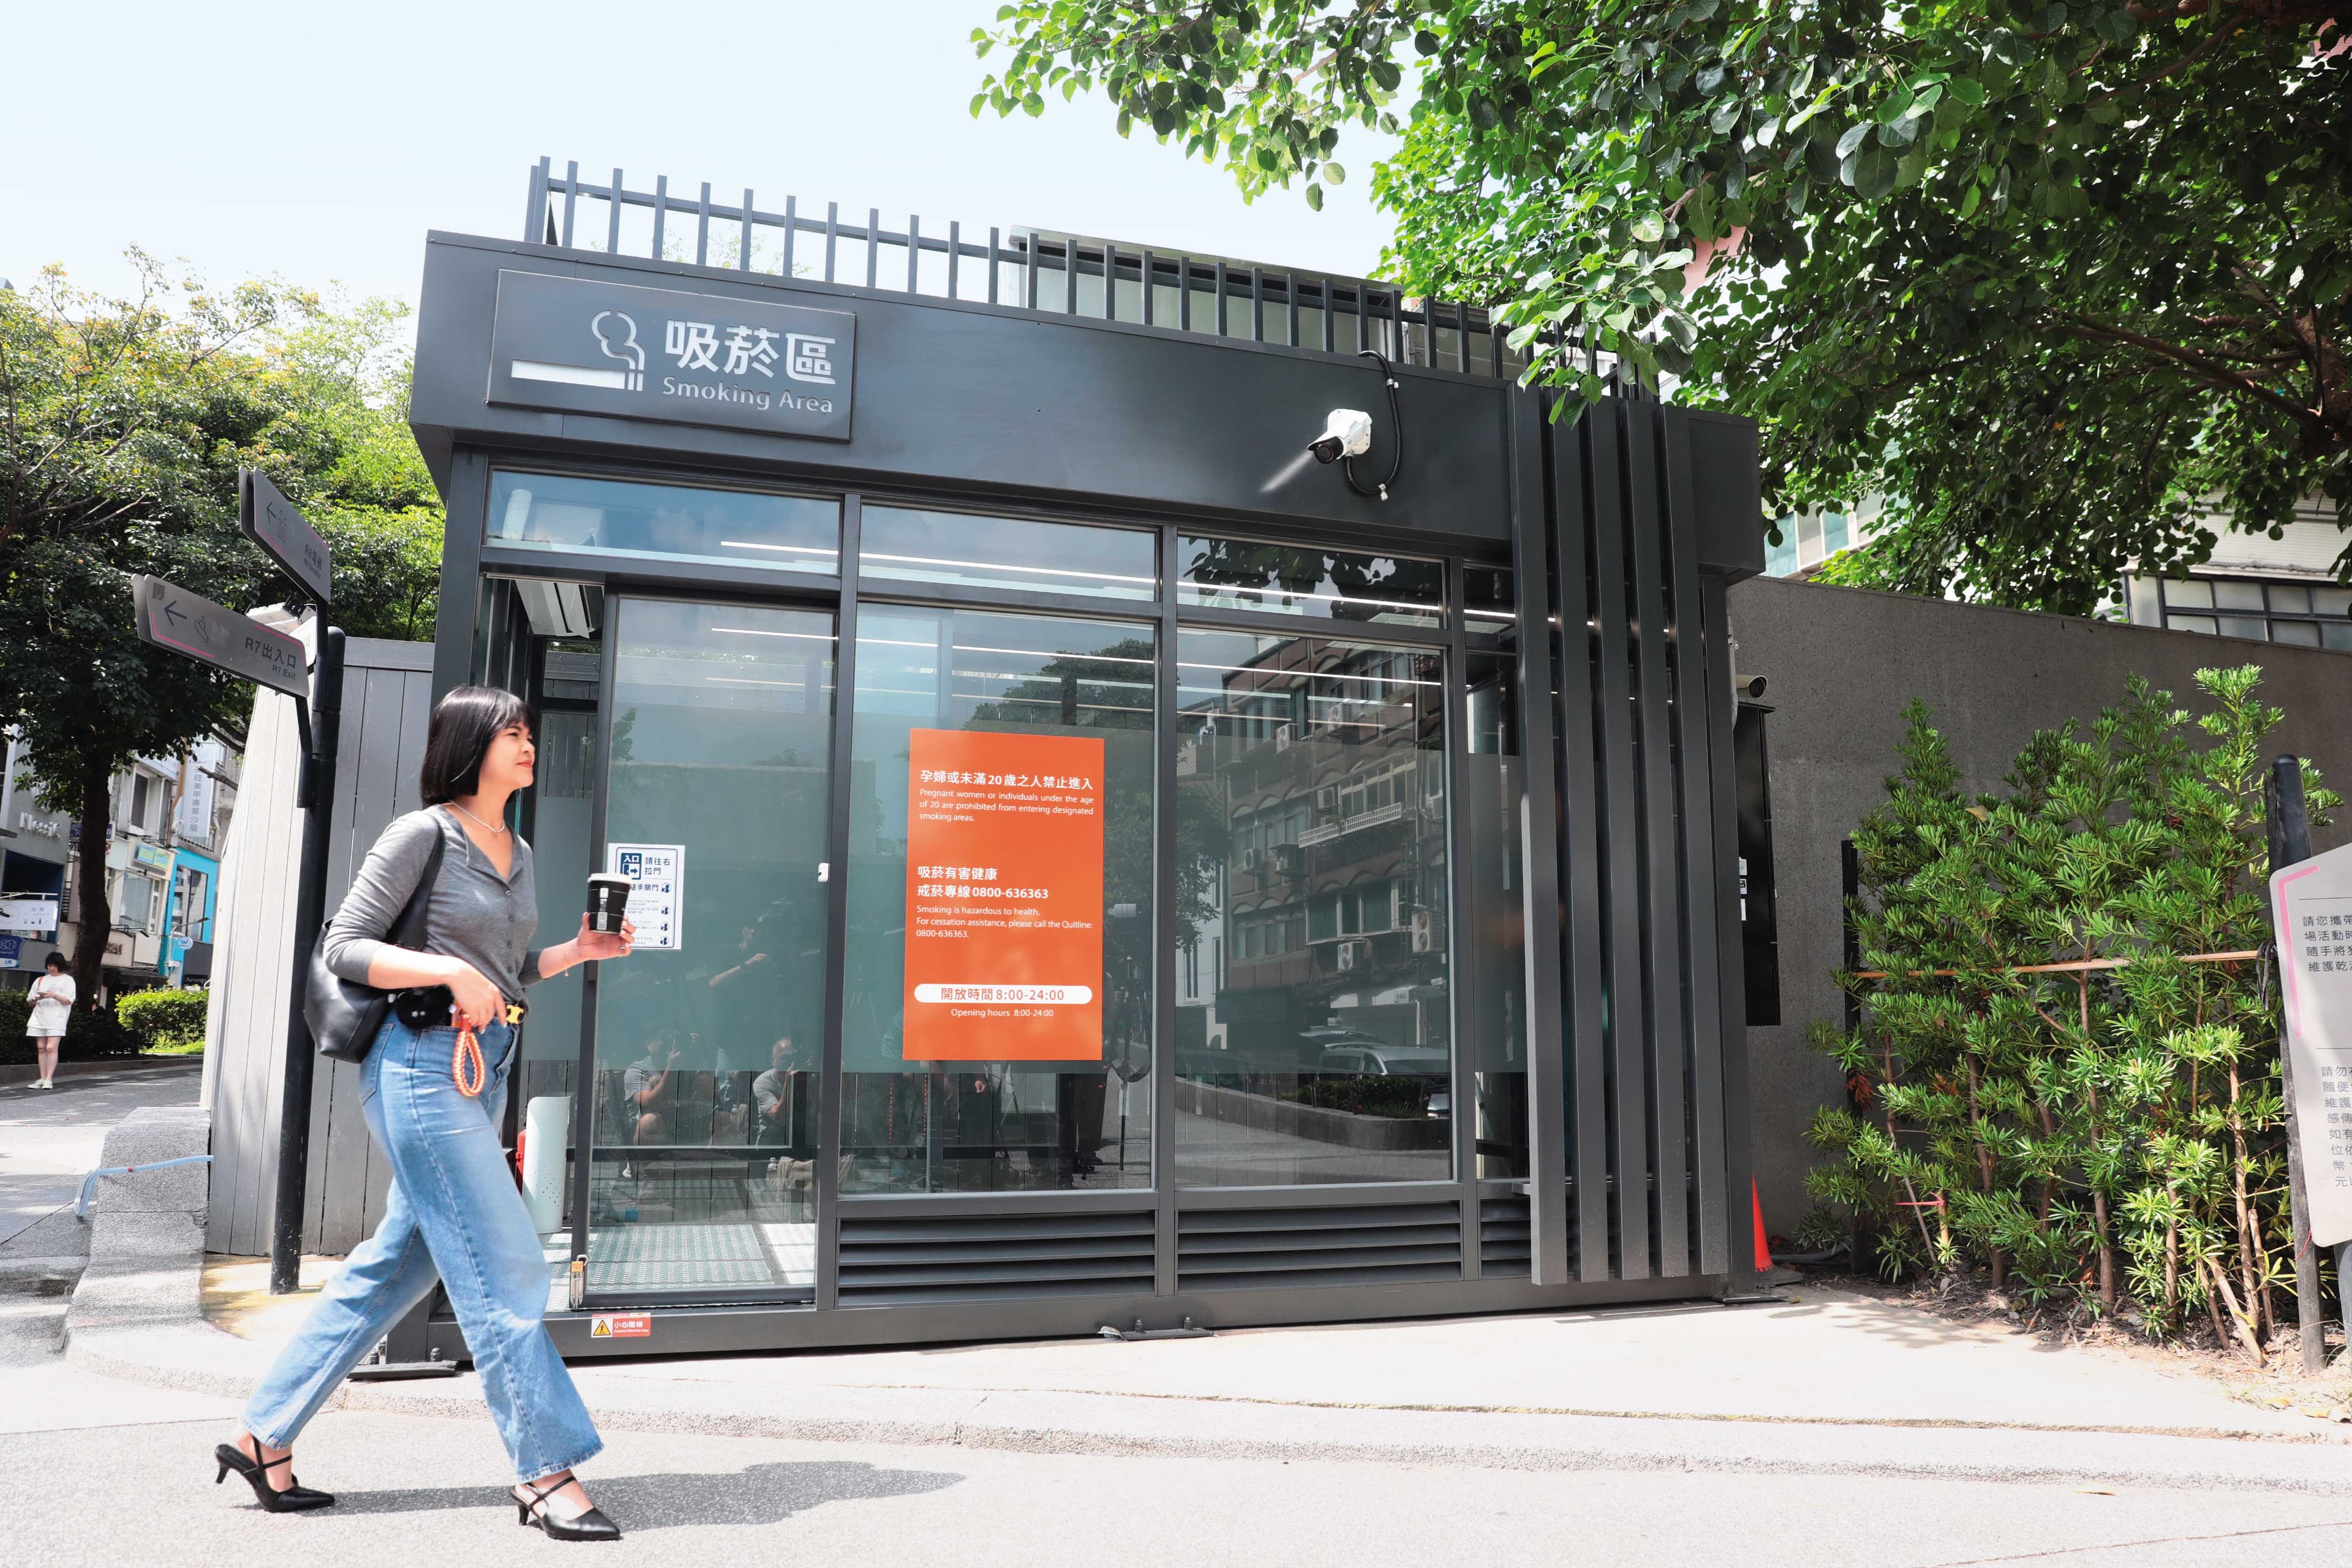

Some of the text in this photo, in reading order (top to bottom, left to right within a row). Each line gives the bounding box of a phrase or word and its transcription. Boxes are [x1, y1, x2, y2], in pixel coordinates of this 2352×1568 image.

[665, 319, 836, 385] 吸菸區
[662, 375, 832, 413] Smoking Area
[245, 636, 296, 669] R7出入口
[273, 664, 296, 680] R7 Exit
[920, 789, 954, 798] Pregnant
[1019, 805, 1050, 815] entering
[1053, 806, 1093, 815] designated
[919, 813, 951, 822] smoking
[645, 857, 671, 865] 請往右
[918, 866, 997, 880] 吸菸有害健康
[917, 905, 952, 915] Smoking
[2308, 961, 2352, 972] 維護乾
[951, 1009, 986, 1018] Opening
[2323, 1081, 2352, 1092] 隨便
[2324, 1097, 2352, 1108] 維護
